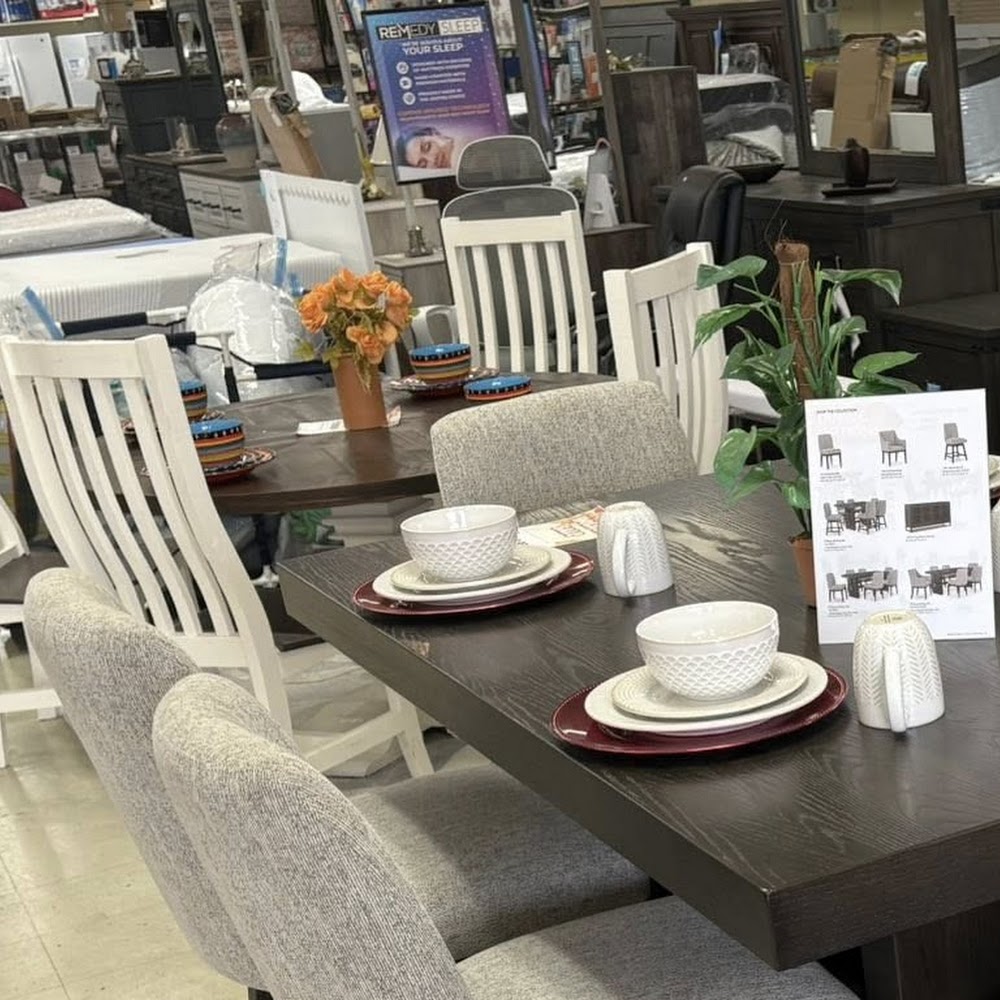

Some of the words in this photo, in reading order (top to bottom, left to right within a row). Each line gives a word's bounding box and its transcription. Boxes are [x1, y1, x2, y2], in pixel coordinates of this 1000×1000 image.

[379, 23, 436, 39] REMEDY
[441, 19, 479, 33] SLEEP
[402, 46, 431, 55] YOUR
[432, 43, 463, 53] SLEEP
